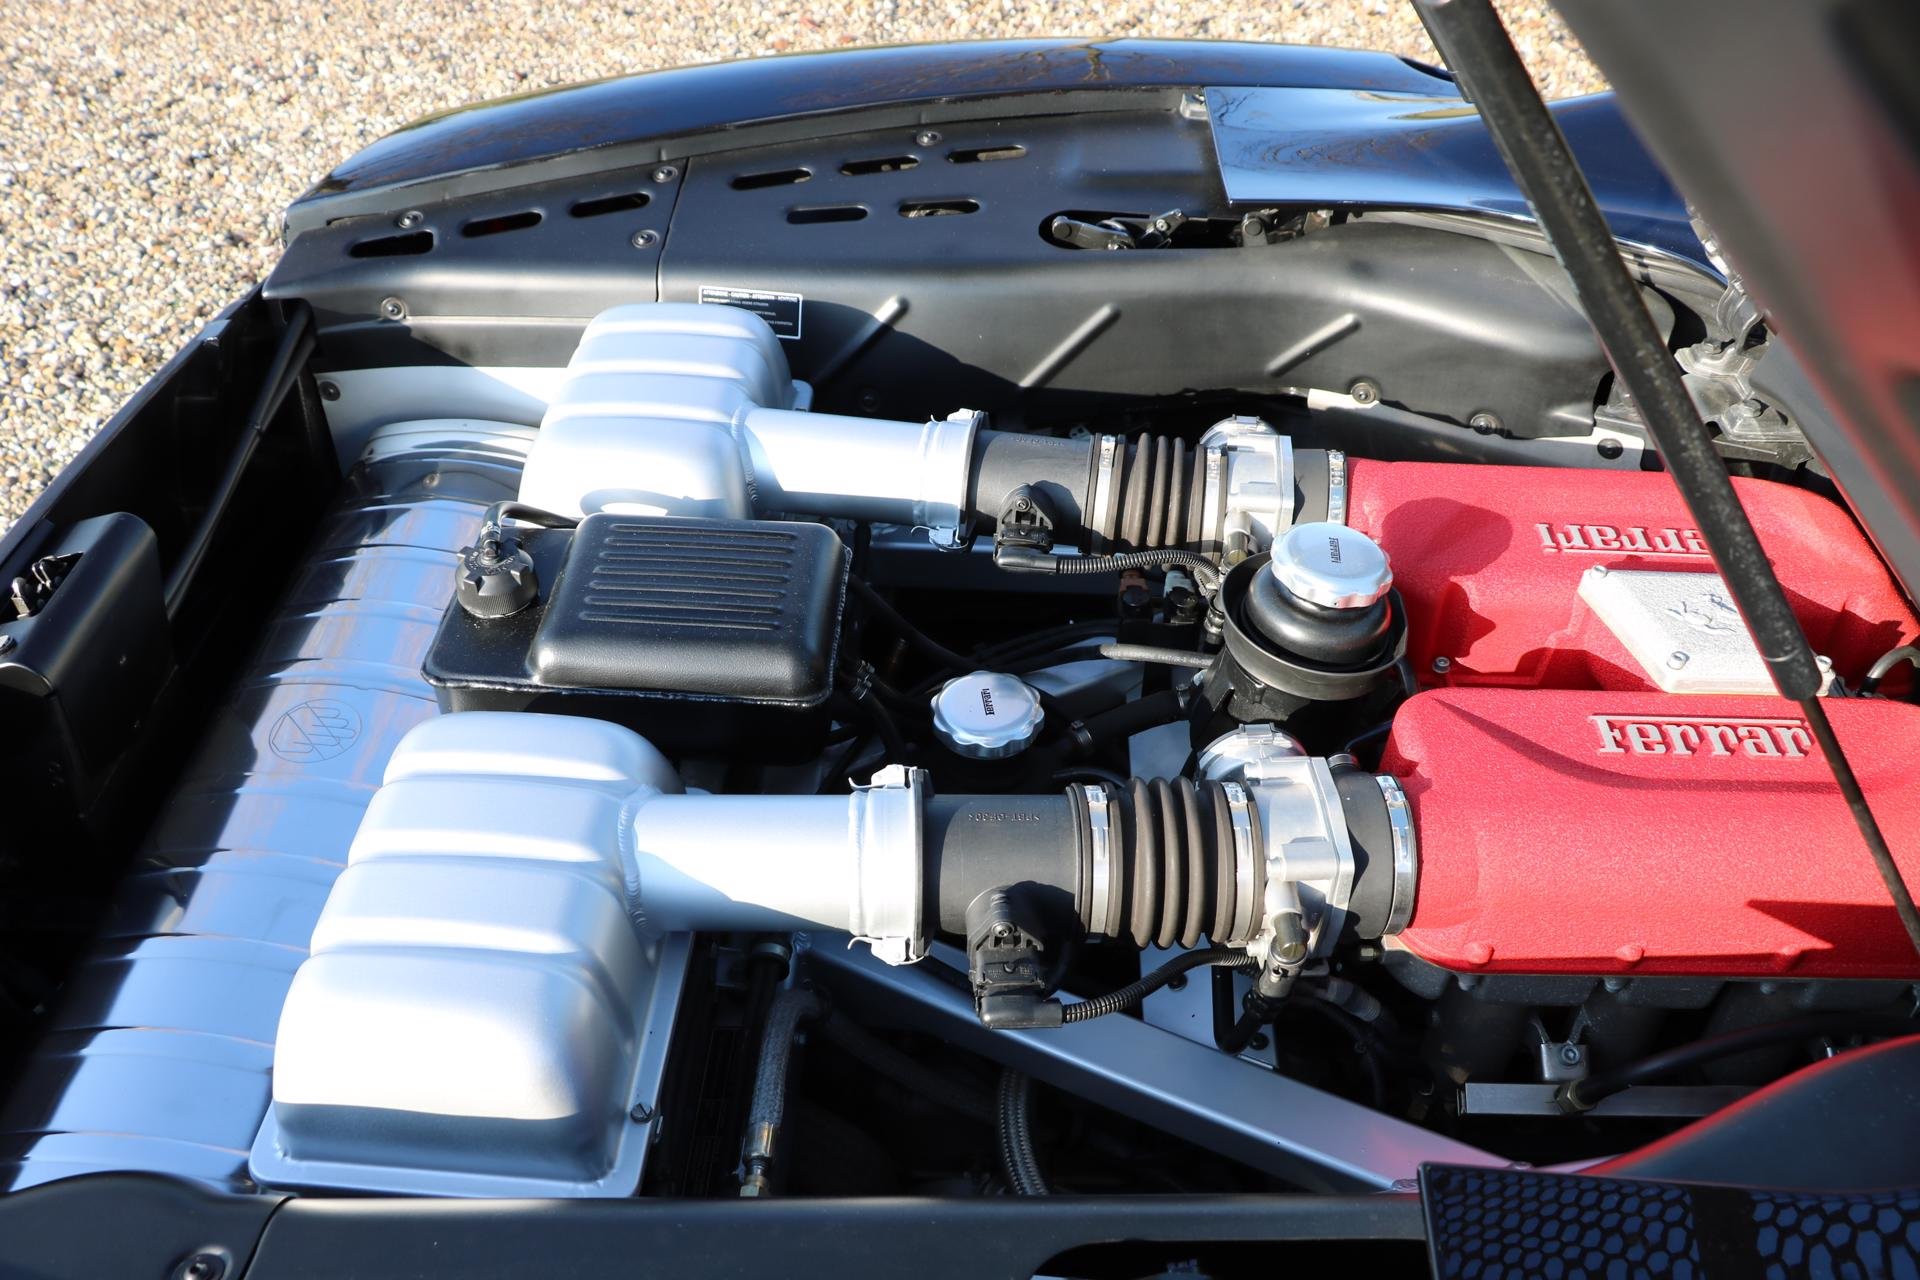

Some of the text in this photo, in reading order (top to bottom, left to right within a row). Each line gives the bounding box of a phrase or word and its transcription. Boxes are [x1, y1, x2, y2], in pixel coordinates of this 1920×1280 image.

[1328, 537, 1342, 564] Ferrari
[1535, 523, 1711, 558] errari
[980, 688, 995, 716] Ferrari
[1588, 715, 1812, 757] Ferrar
